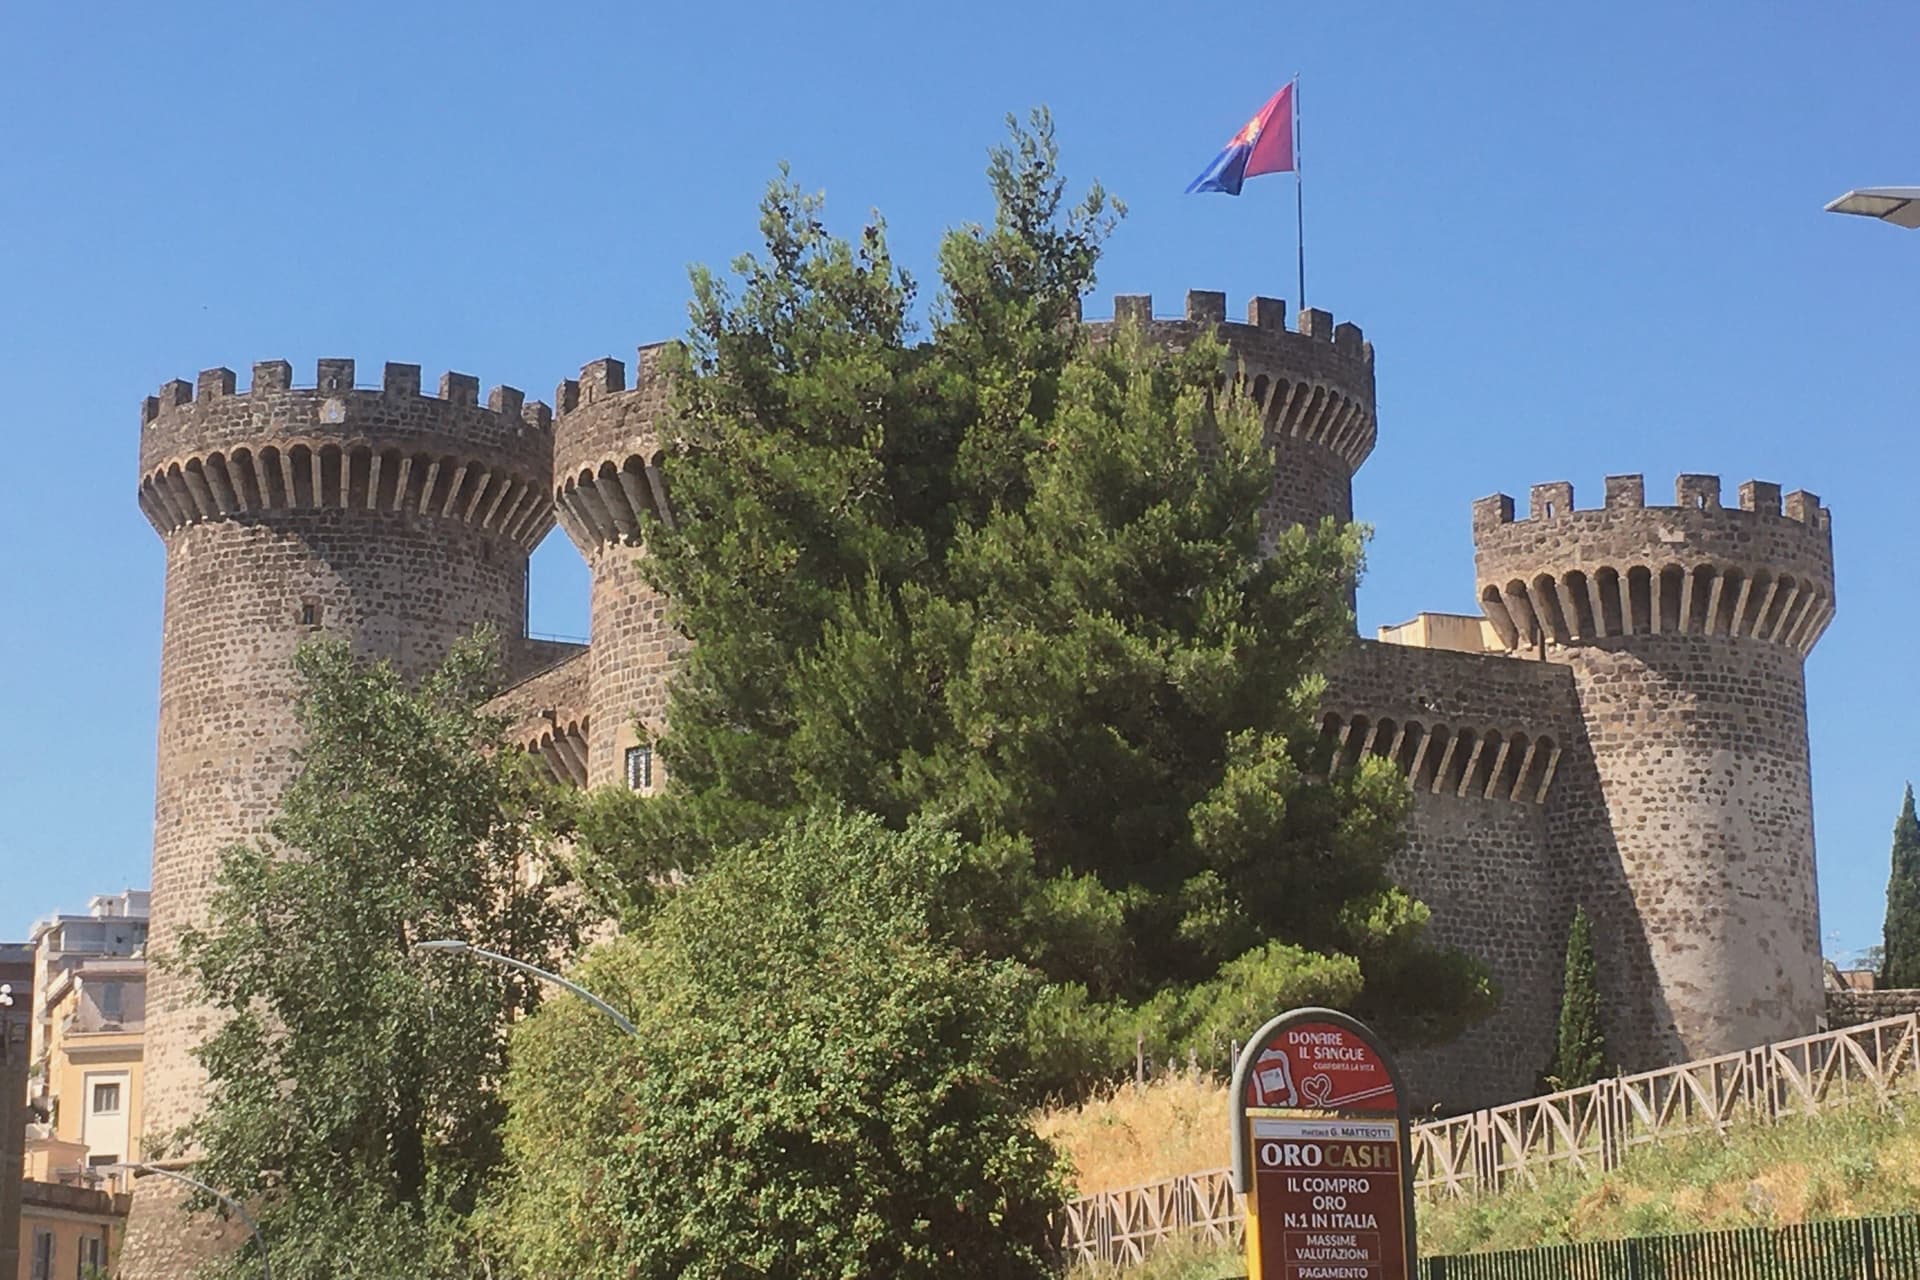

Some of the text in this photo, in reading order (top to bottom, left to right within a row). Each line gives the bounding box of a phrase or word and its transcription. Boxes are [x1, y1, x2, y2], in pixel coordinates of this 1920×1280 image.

[1289, 1032, 1343, 1046] DONARE
[1299, 1047, 1365, 1061] IL SANGUE
[1341, 1127, 1391, 1138] MATTEOTTI
[1288, 1177, 1370, 1193] IL COMPRO
[1312, 1196, 1347, 1211] ORO
[1284, 1213, 1378, 1229] N.1 IN ITALIA
[1306, 1234, 1357, 1247] MASSIME
[1295, 1248, 1369, 1260] VALUTAZIONI
[1298, 1267, 1369, 1279] PAGAMENTO
